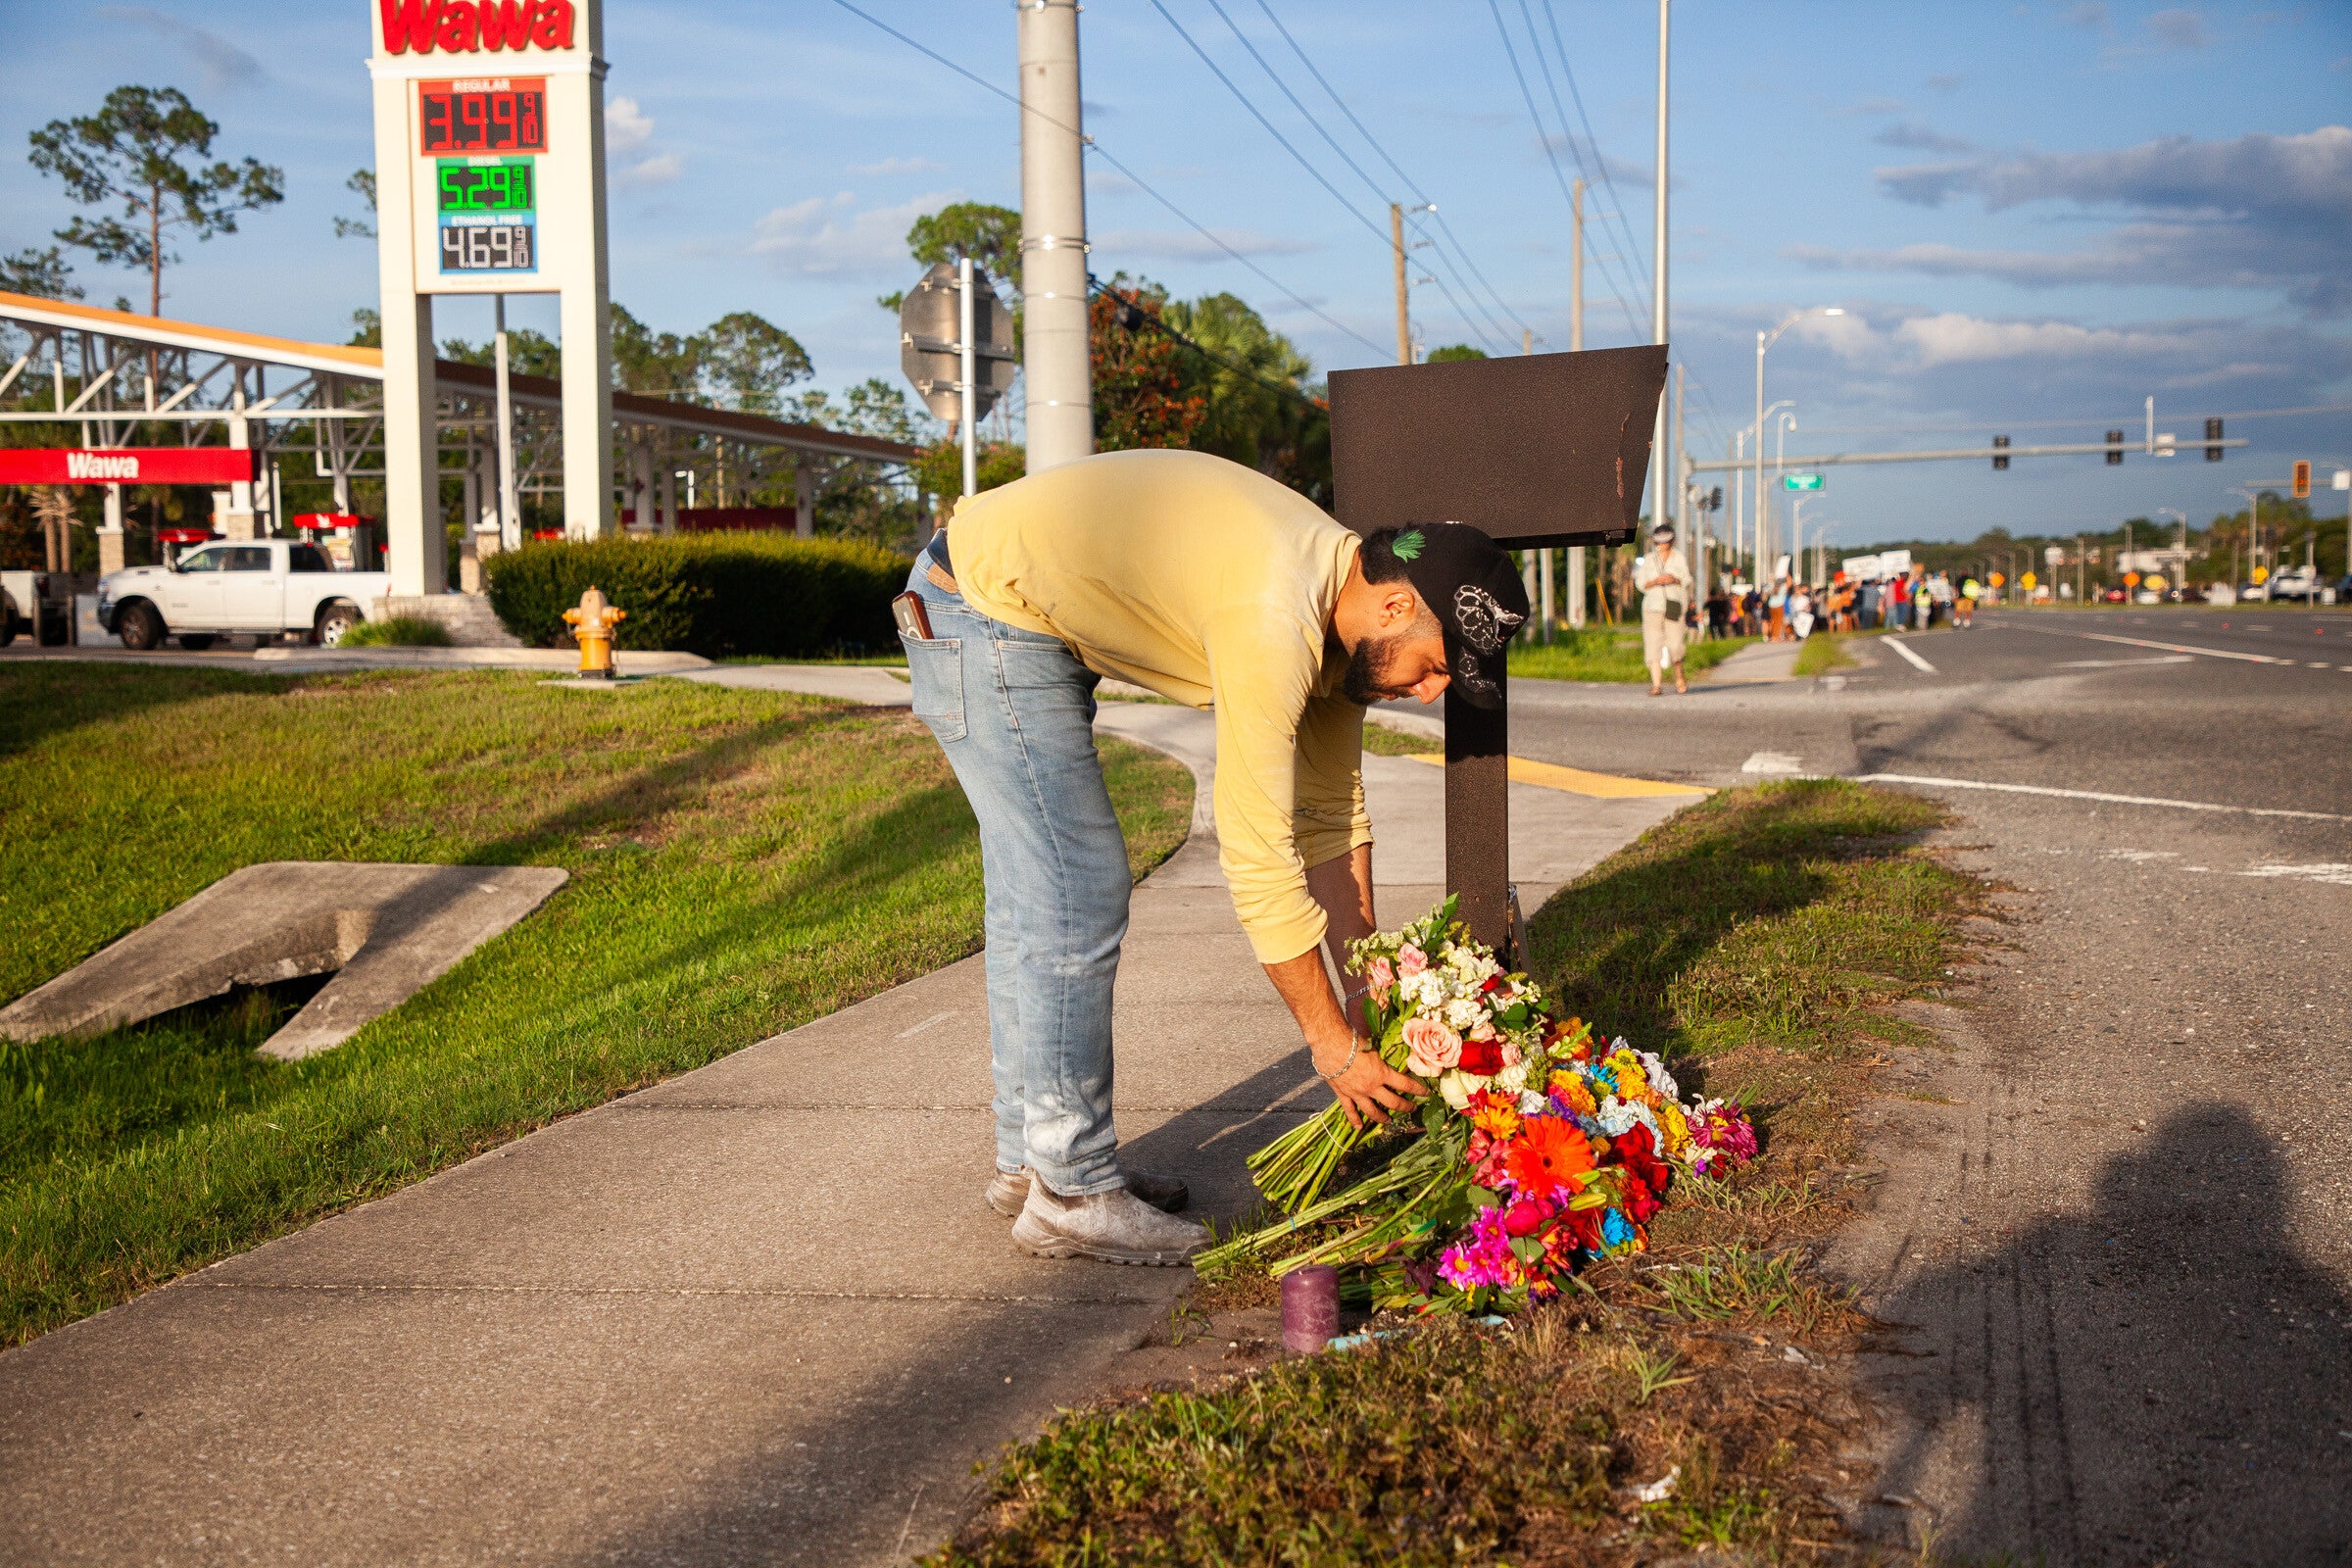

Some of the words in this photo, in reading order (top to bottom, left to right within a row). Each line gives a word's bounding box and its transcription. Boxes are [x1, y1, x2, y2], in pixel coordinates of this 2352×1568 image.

[378, 0, 576, 55] Wawa
[452, 79, 512, 94] REGULAR
[429, 93, 518, 150] 3.99
[498, 214, 523, 225] FREE
[67, 452, 140, 479] Wawa
